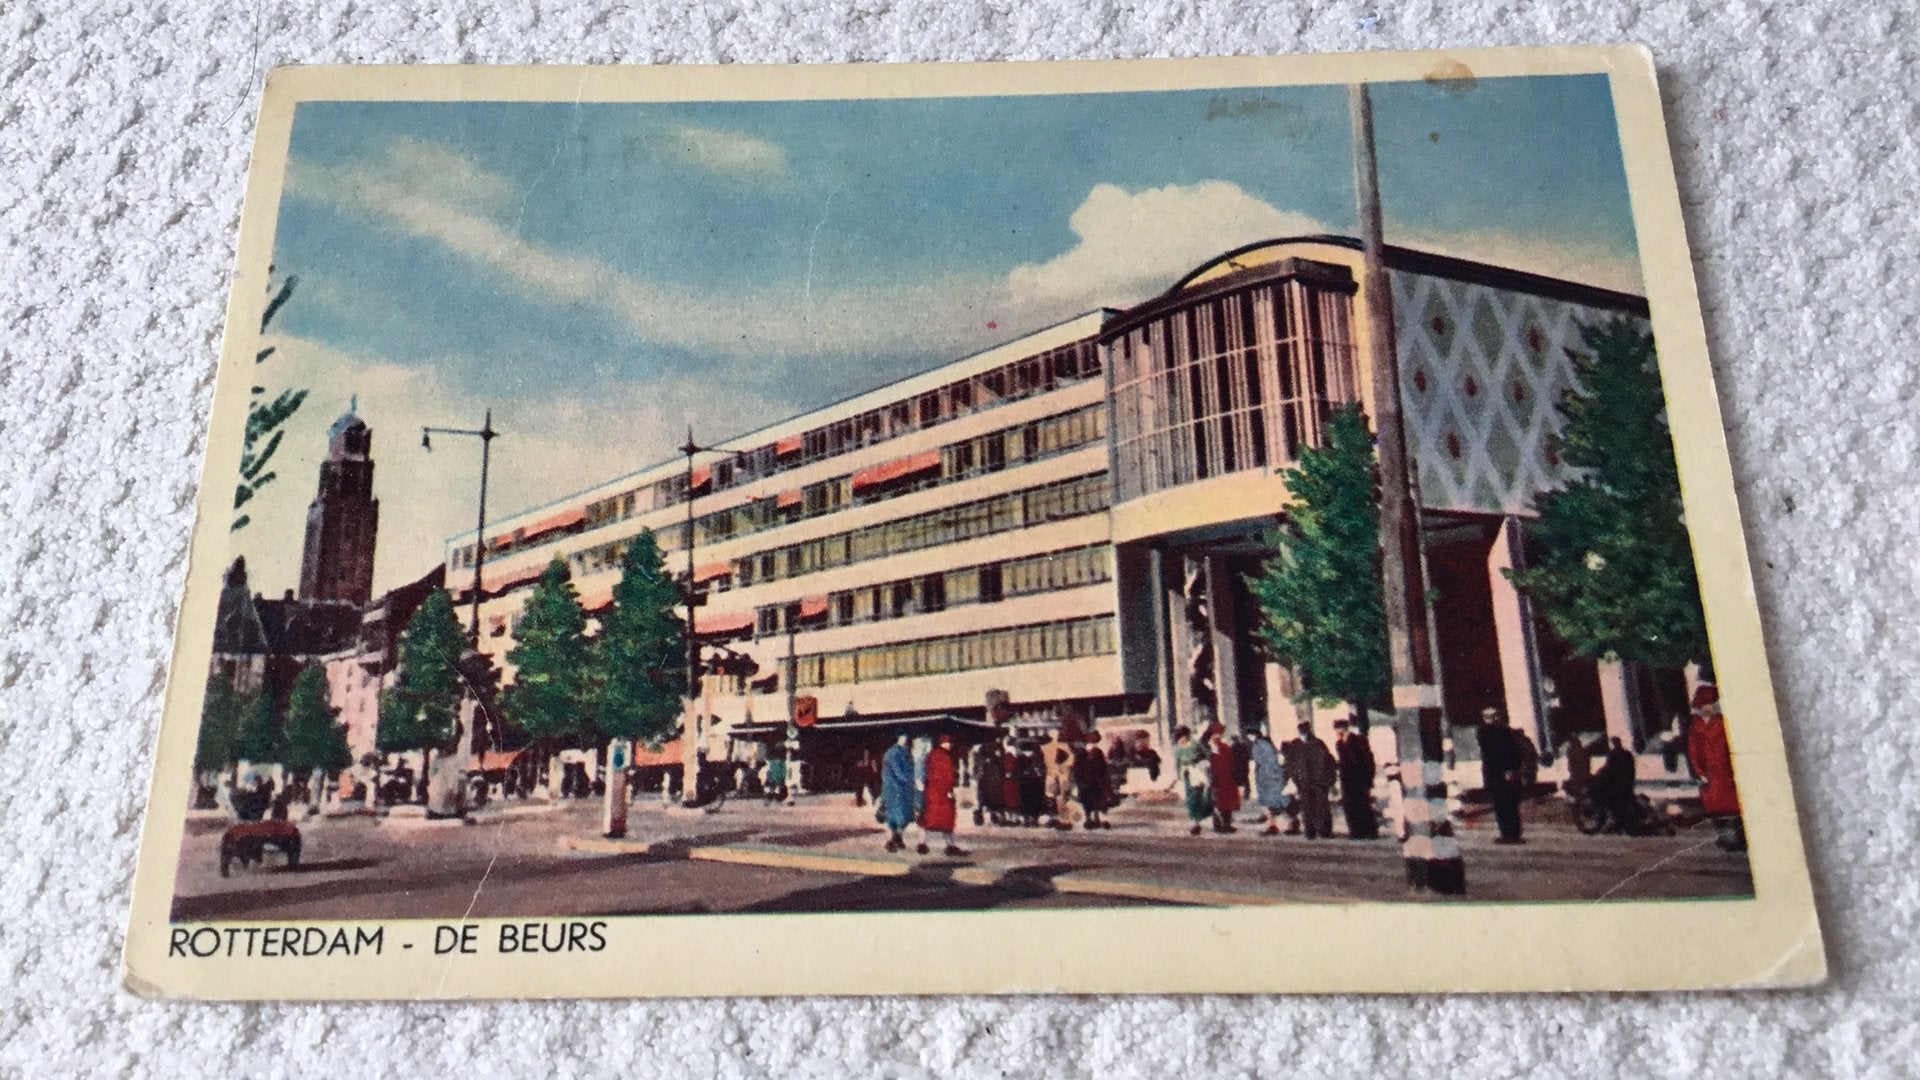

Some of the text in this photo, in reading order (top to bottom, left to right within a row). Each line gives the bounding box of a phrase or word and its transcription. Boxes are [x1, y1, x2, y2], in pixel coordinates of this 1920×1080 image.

[169, 927, 384, 957] ROTTERDAM
[434, 925, 479, 955] DE
[498, 921, 608, 953] BEURS
